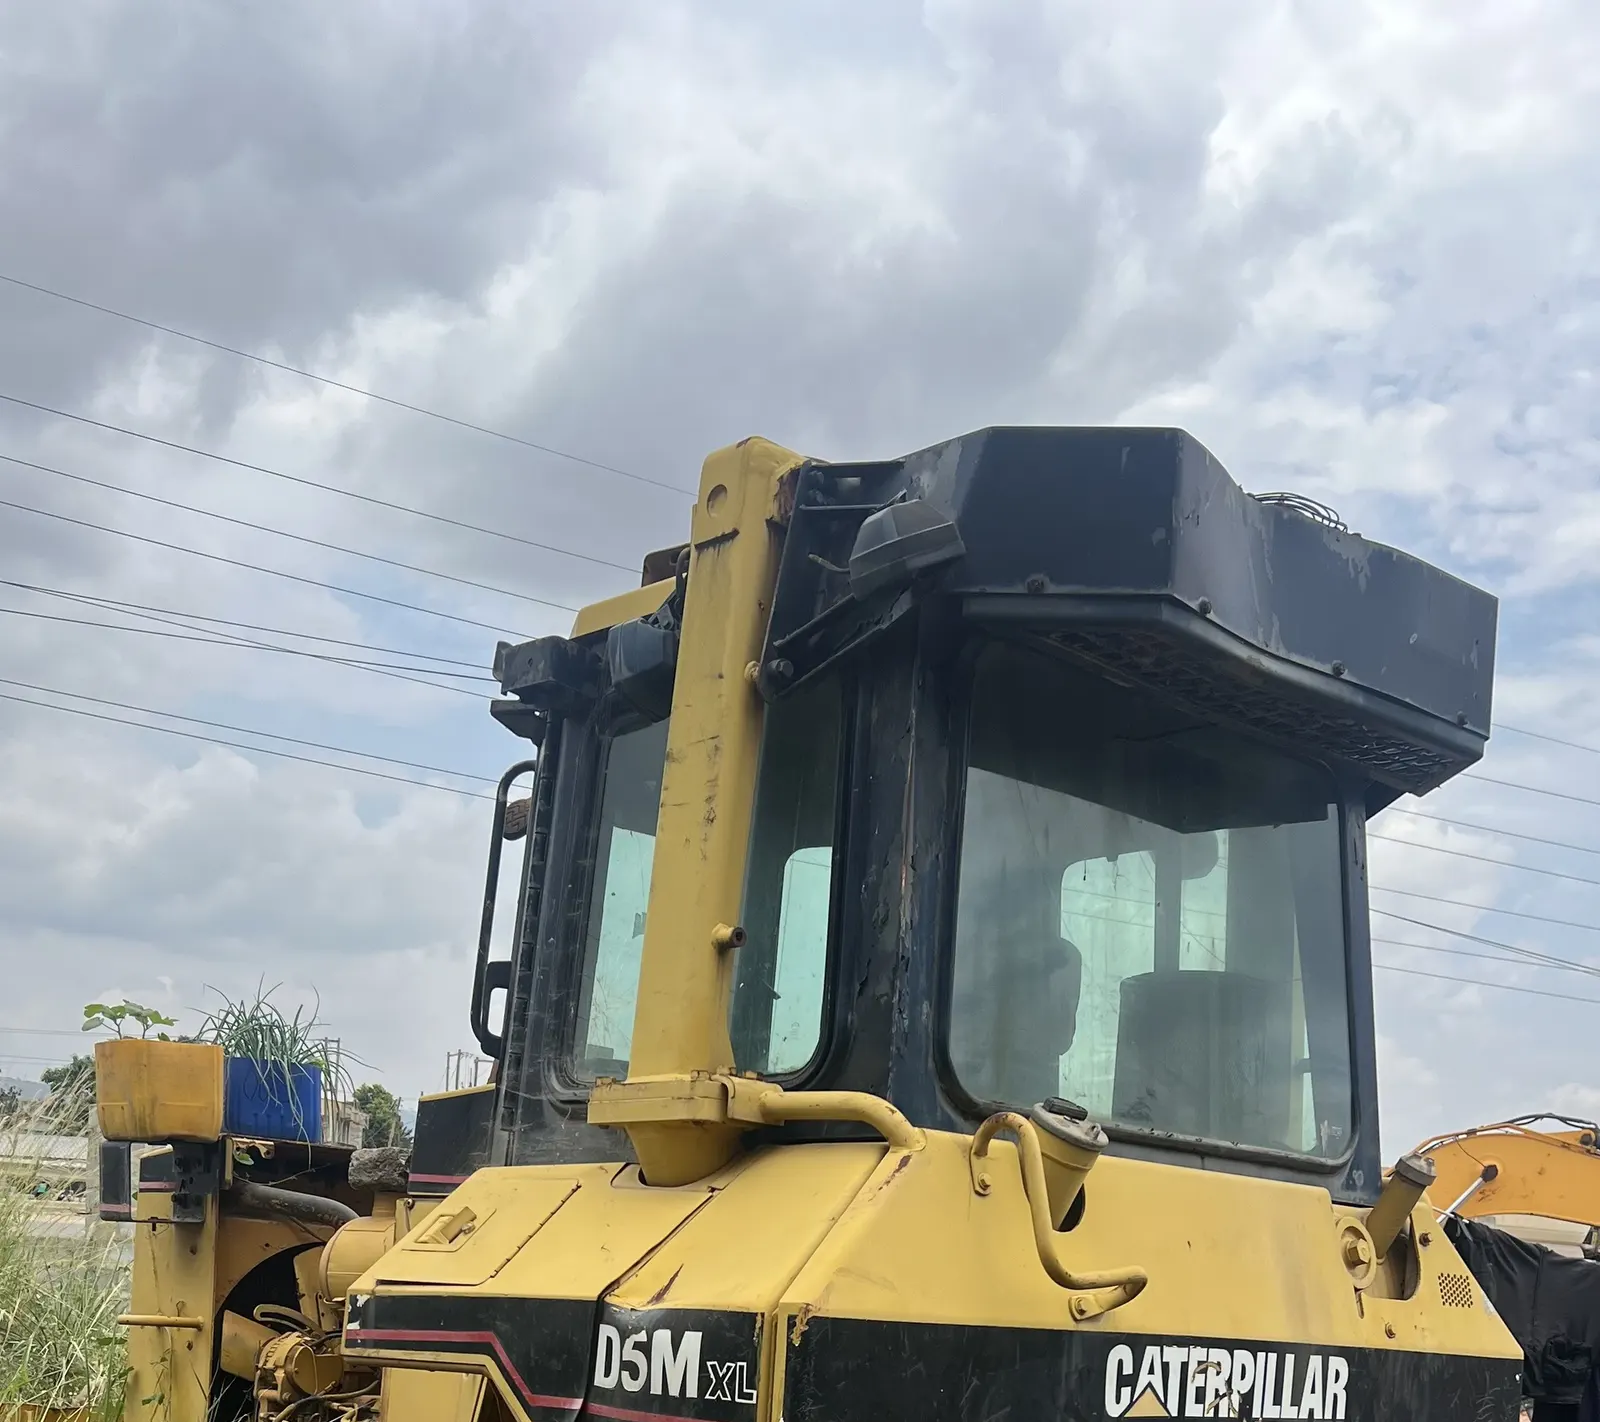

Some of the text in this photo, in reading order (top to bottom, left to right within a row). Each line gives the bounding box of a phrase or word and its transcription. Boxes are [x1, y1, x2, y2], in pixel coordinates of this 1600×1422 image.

[594, 1323, 758, 1405] D5M XL
[1104, 1344, 1350, 1420] CATERPILLAR
